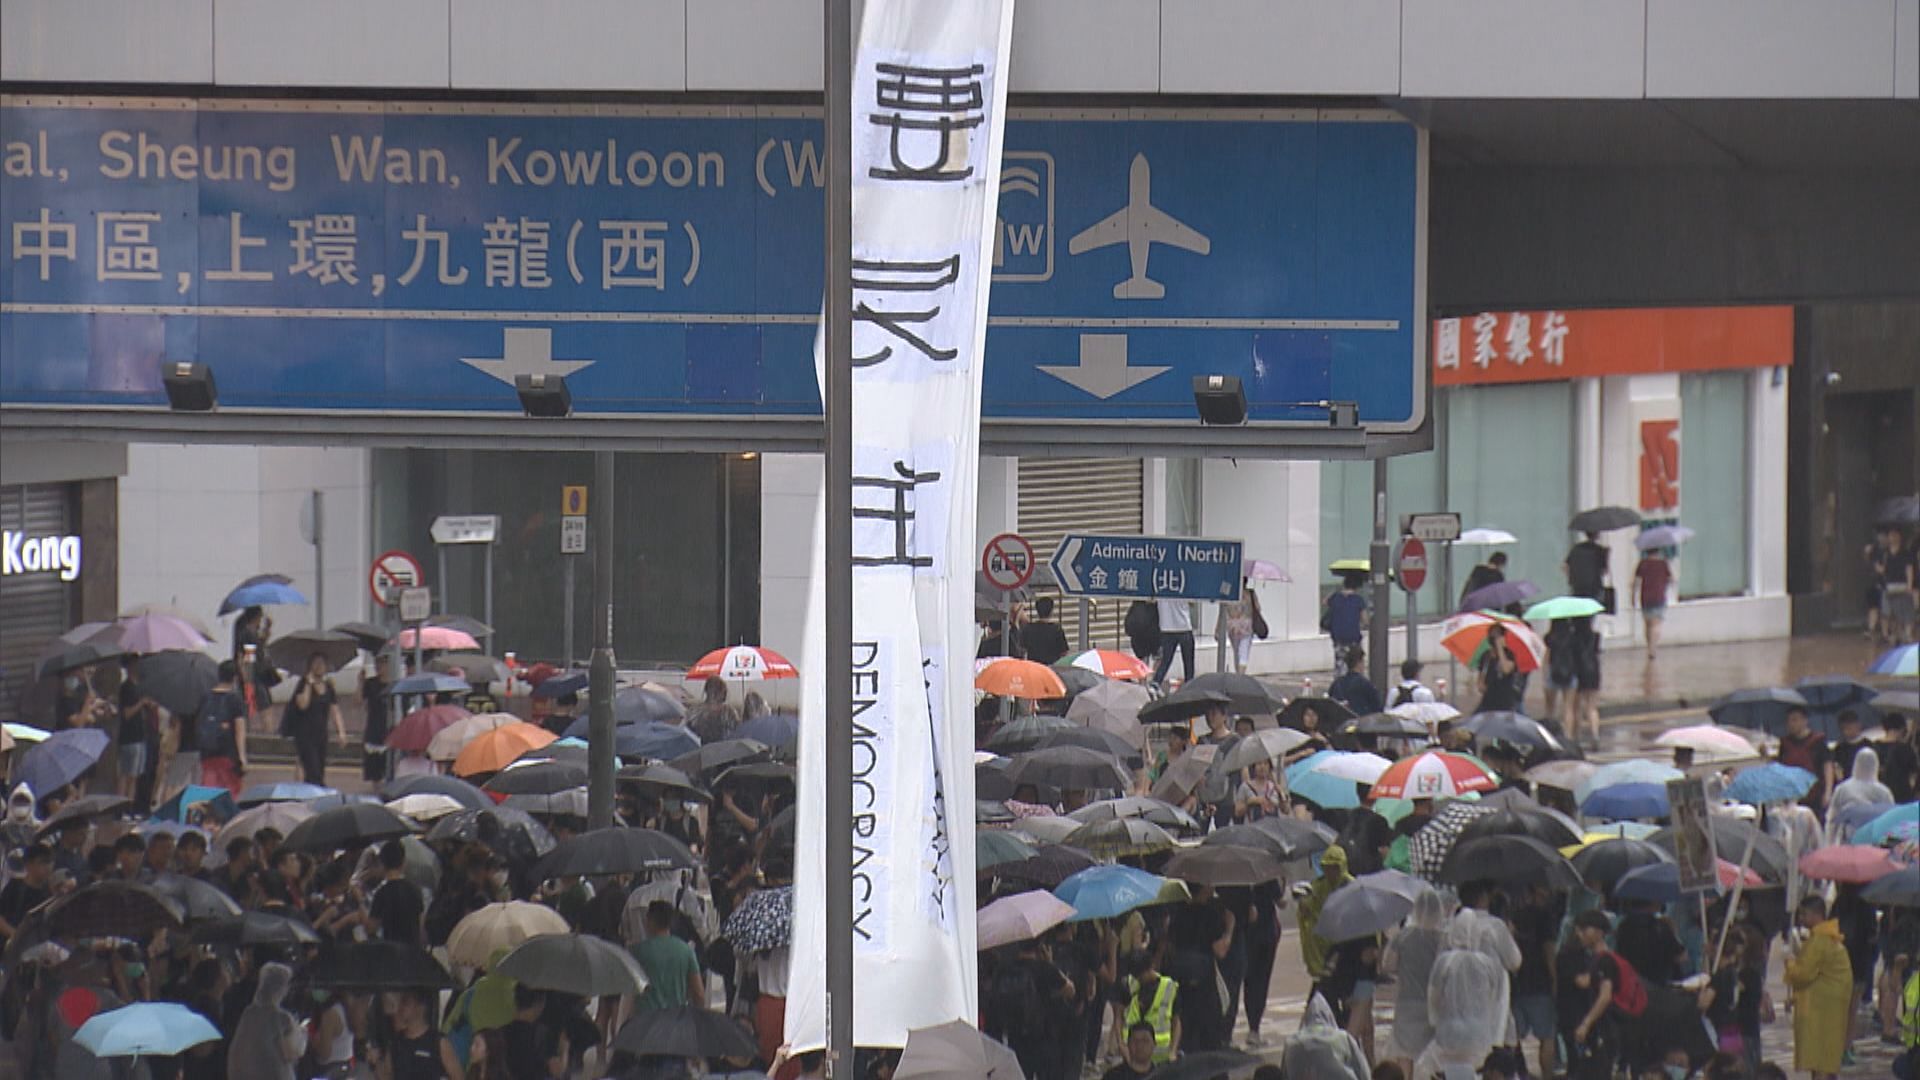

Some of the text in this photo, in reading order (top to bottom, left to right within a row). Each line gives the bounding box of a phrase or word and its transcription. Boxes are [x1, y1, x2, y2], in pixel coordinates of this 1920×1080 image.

[99, 130, 297, 193] Sheung
[331, 134, 461, 189] Wan,
[488, 138, 726, 188] Kowloon
[2, 530, 81, 582] Kong
[1091, 542, 1235, 563] Admiralty (North)
